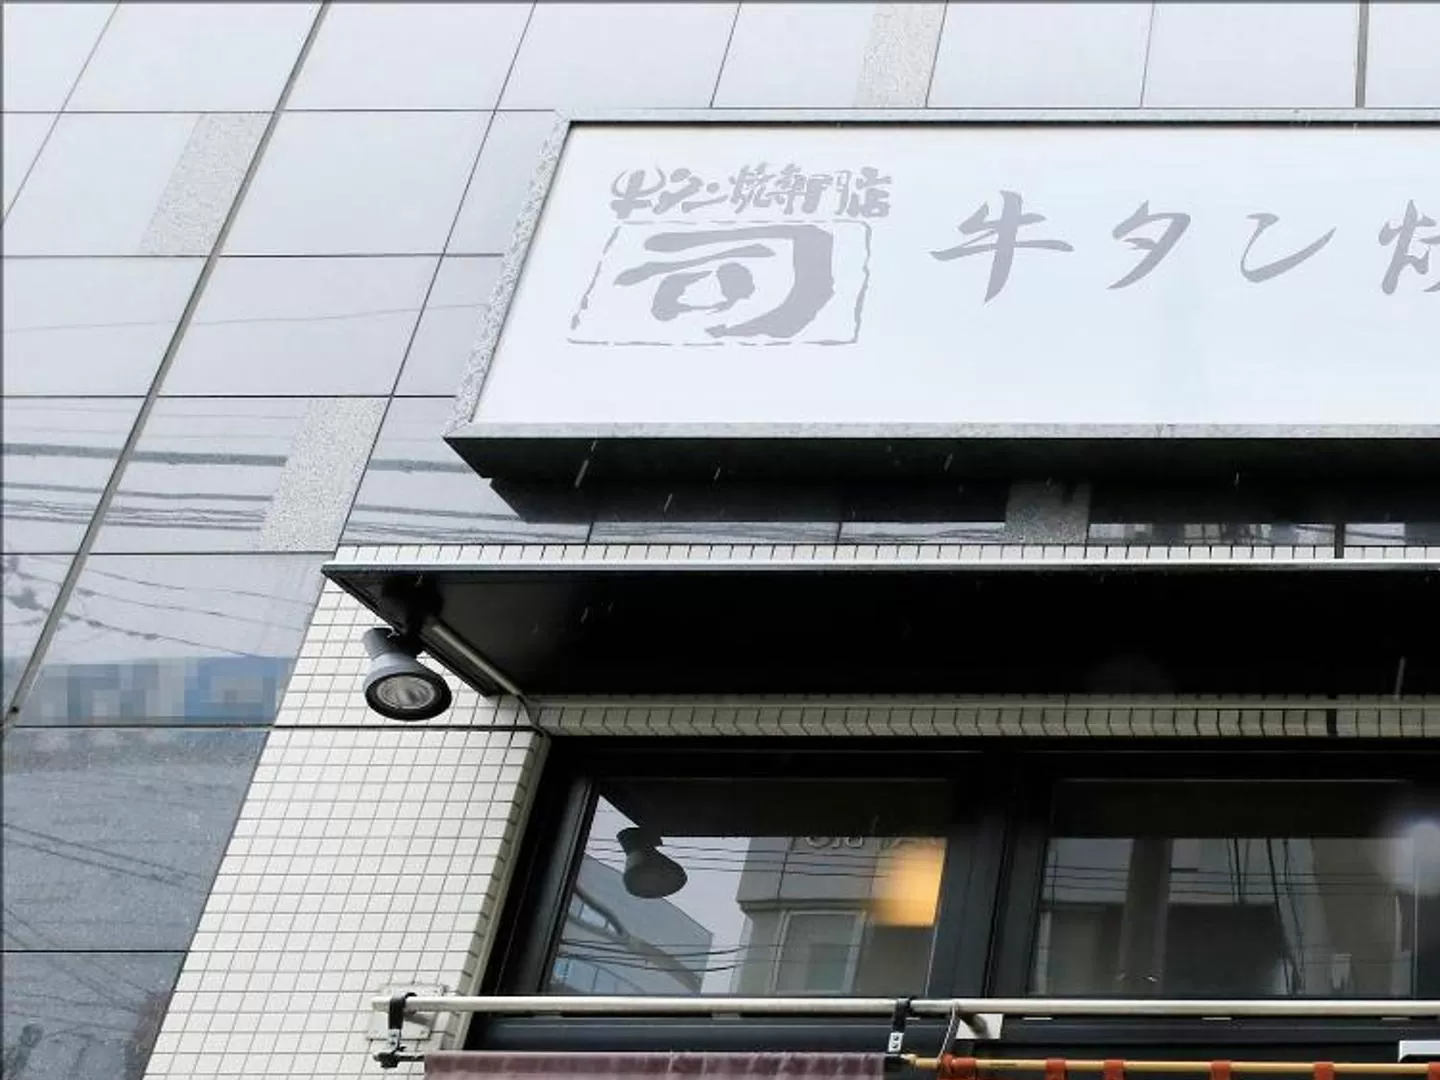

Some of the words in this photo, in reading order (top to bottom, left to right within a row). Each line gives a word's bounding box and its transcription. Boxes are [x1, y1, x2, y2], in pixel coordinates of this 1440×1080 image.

[609, 162, 892, 219] 牛タン焼専門店
[615, 223, 834, 339] 司
